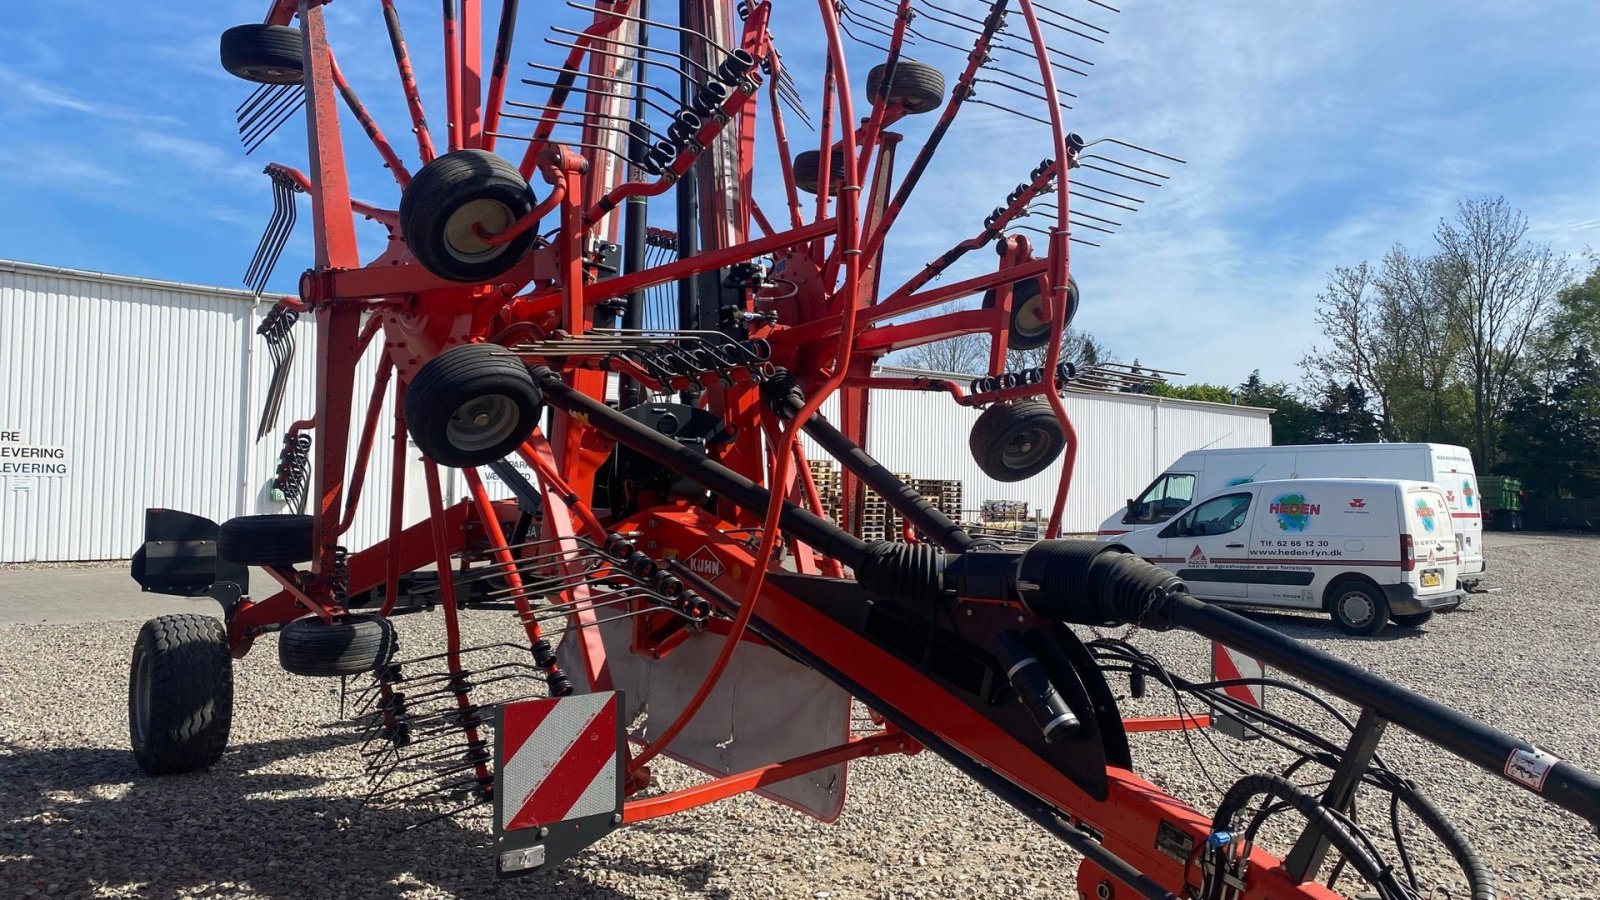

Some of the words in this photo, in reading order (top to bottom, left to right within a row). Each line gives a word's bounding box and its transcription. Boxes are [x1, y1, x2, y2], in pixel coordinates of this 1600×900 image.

[1, 431, 20, 441] RE
[0, 447, 64, 459] EVERING
[0, 462, 66, 474] EVERING
[1269, 503, 1321, 515] HEDEN
[1250, 549, 1342, 557] www.heden-fyn.dk
[690, 557, 720, 575] KUHN
